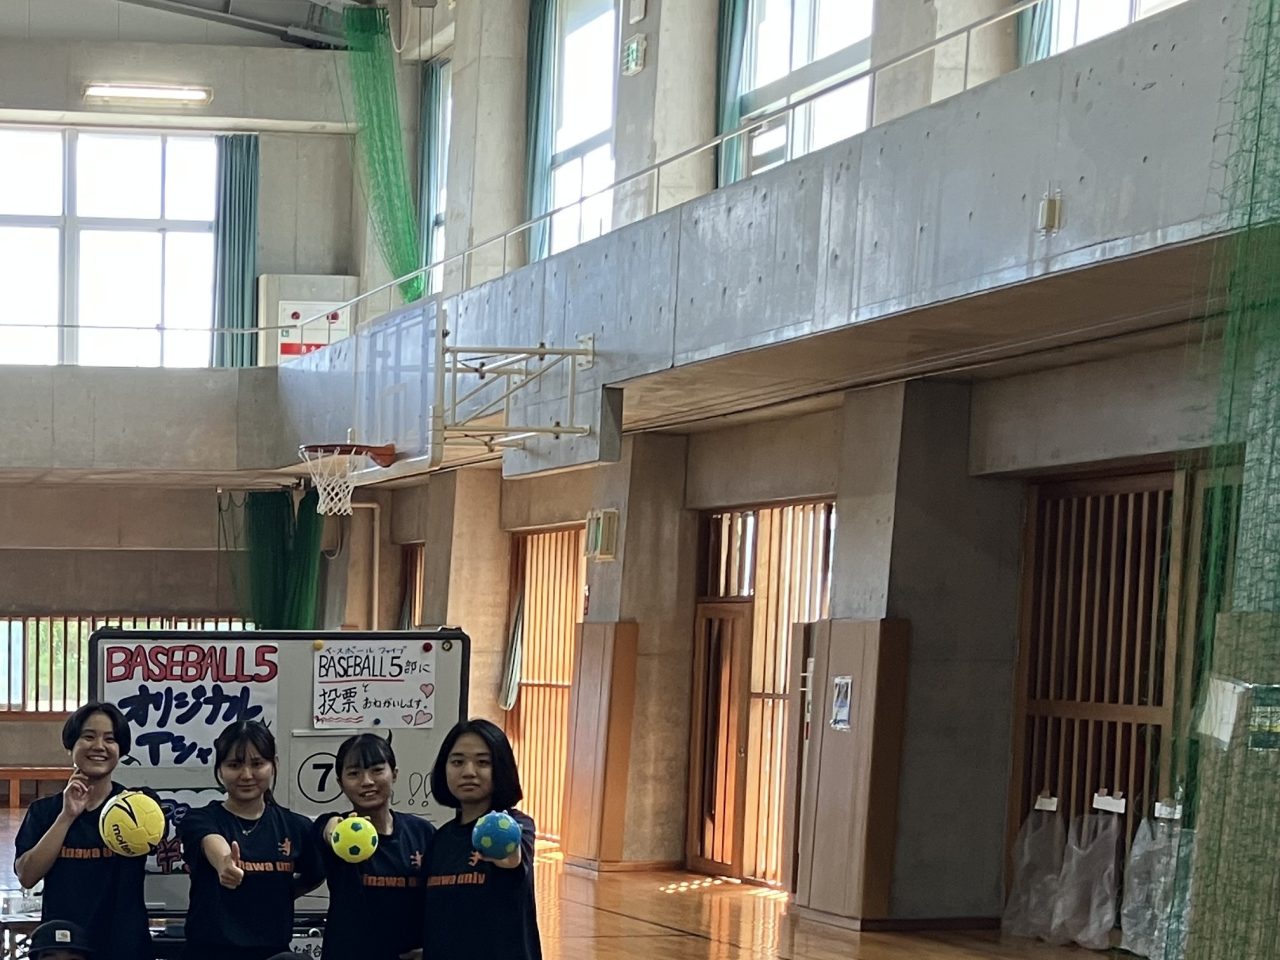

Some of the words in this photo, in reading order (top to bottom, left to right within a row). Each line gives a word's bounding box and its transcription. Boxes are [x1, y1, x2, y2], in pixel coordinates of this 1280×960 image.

[106, 644, 278, 683] BASEBALL5
[117, 684, 263, 728] オリジナル
[318, 686, 360, 715] 投票
[135, 731, 213, 766] Tシャ
